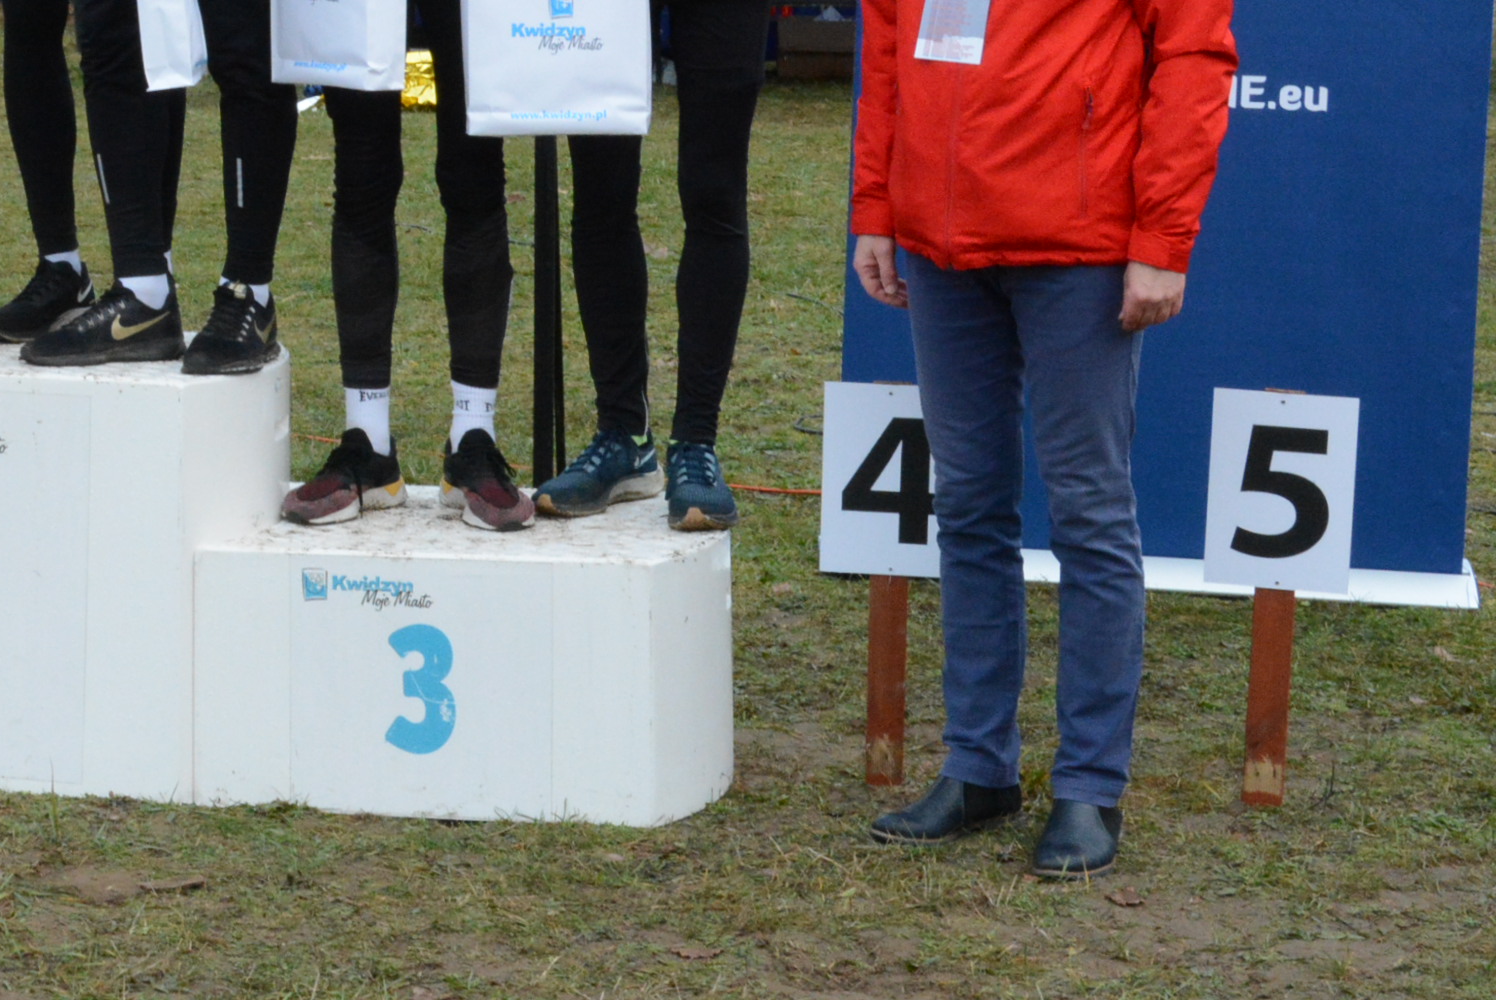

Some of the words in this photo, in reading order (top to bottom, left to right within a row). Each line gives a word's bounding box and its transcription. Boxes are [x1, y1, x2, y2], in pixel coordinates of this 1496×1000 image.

[511, 23, 586, 40] Kwidzyn
[538, 35, 565, 55] Moje
[568, 34, 603, 51] Miasto
[1228, 75, 1329, 112] IE.eu
[511, 109, 608, 122] www.kwidzyn.pl
[841, 417, 936, 544] 4
[1229, 424, 1330, 559] 5
[332, 575, 414, 597] Kwidzyn
[361, 589, 391, 611] Moje
[393, 590, 434, 610] Miasto
[385, 623, 456, 754] 3
